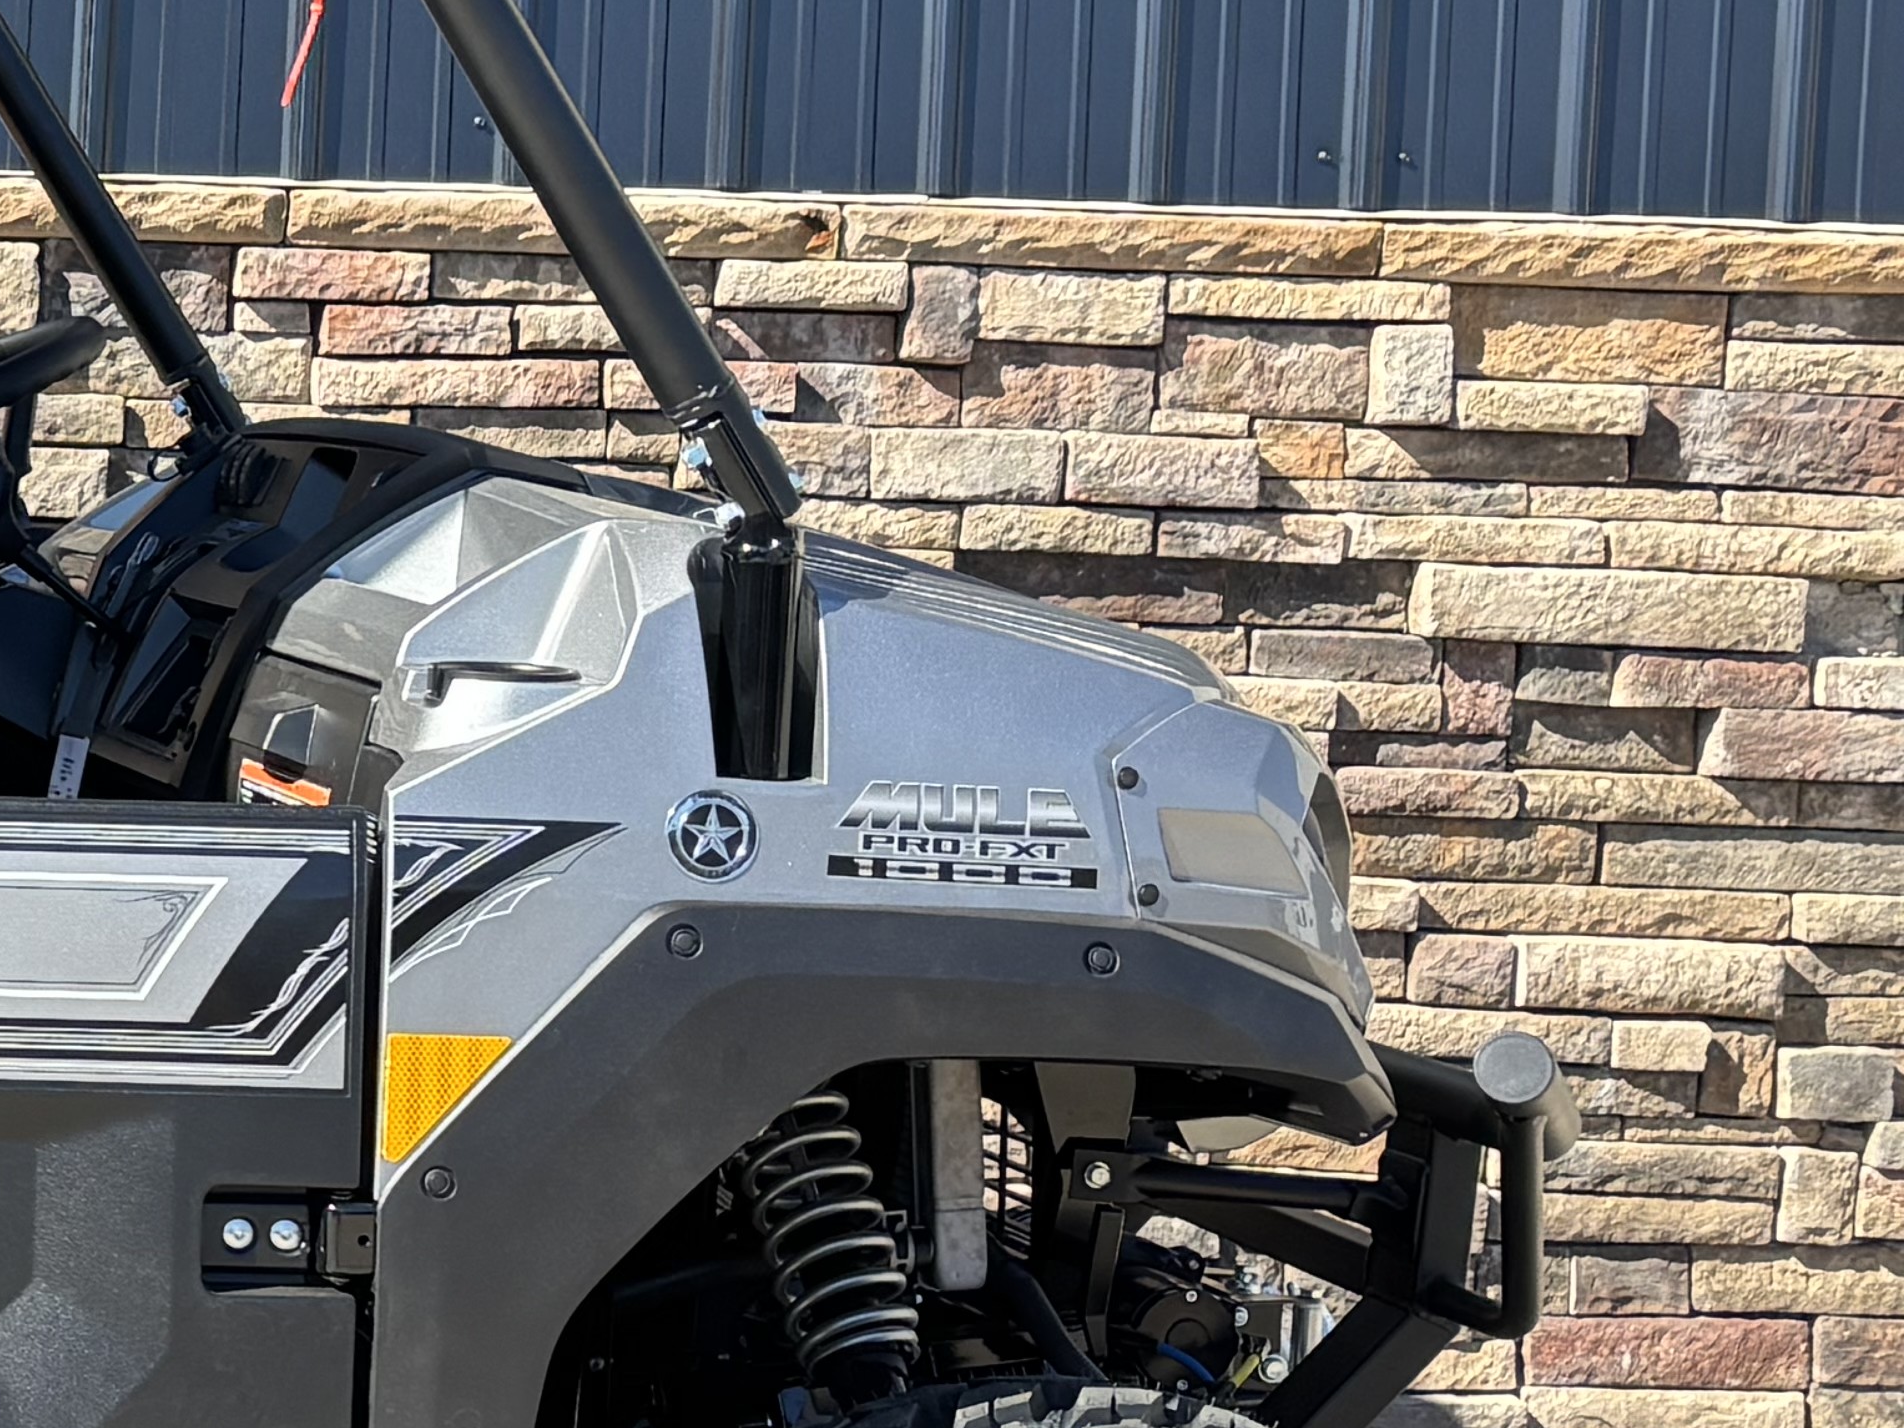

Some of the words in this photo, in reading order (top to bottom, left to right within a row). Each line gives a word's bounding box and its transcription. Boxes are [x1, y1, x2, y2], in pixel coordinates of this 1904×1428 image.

[835, 780, 1092, 839] MULE
[861, 833, 1068, 860] PRO-FXT
[855, 859, 1072, 887] 1000
